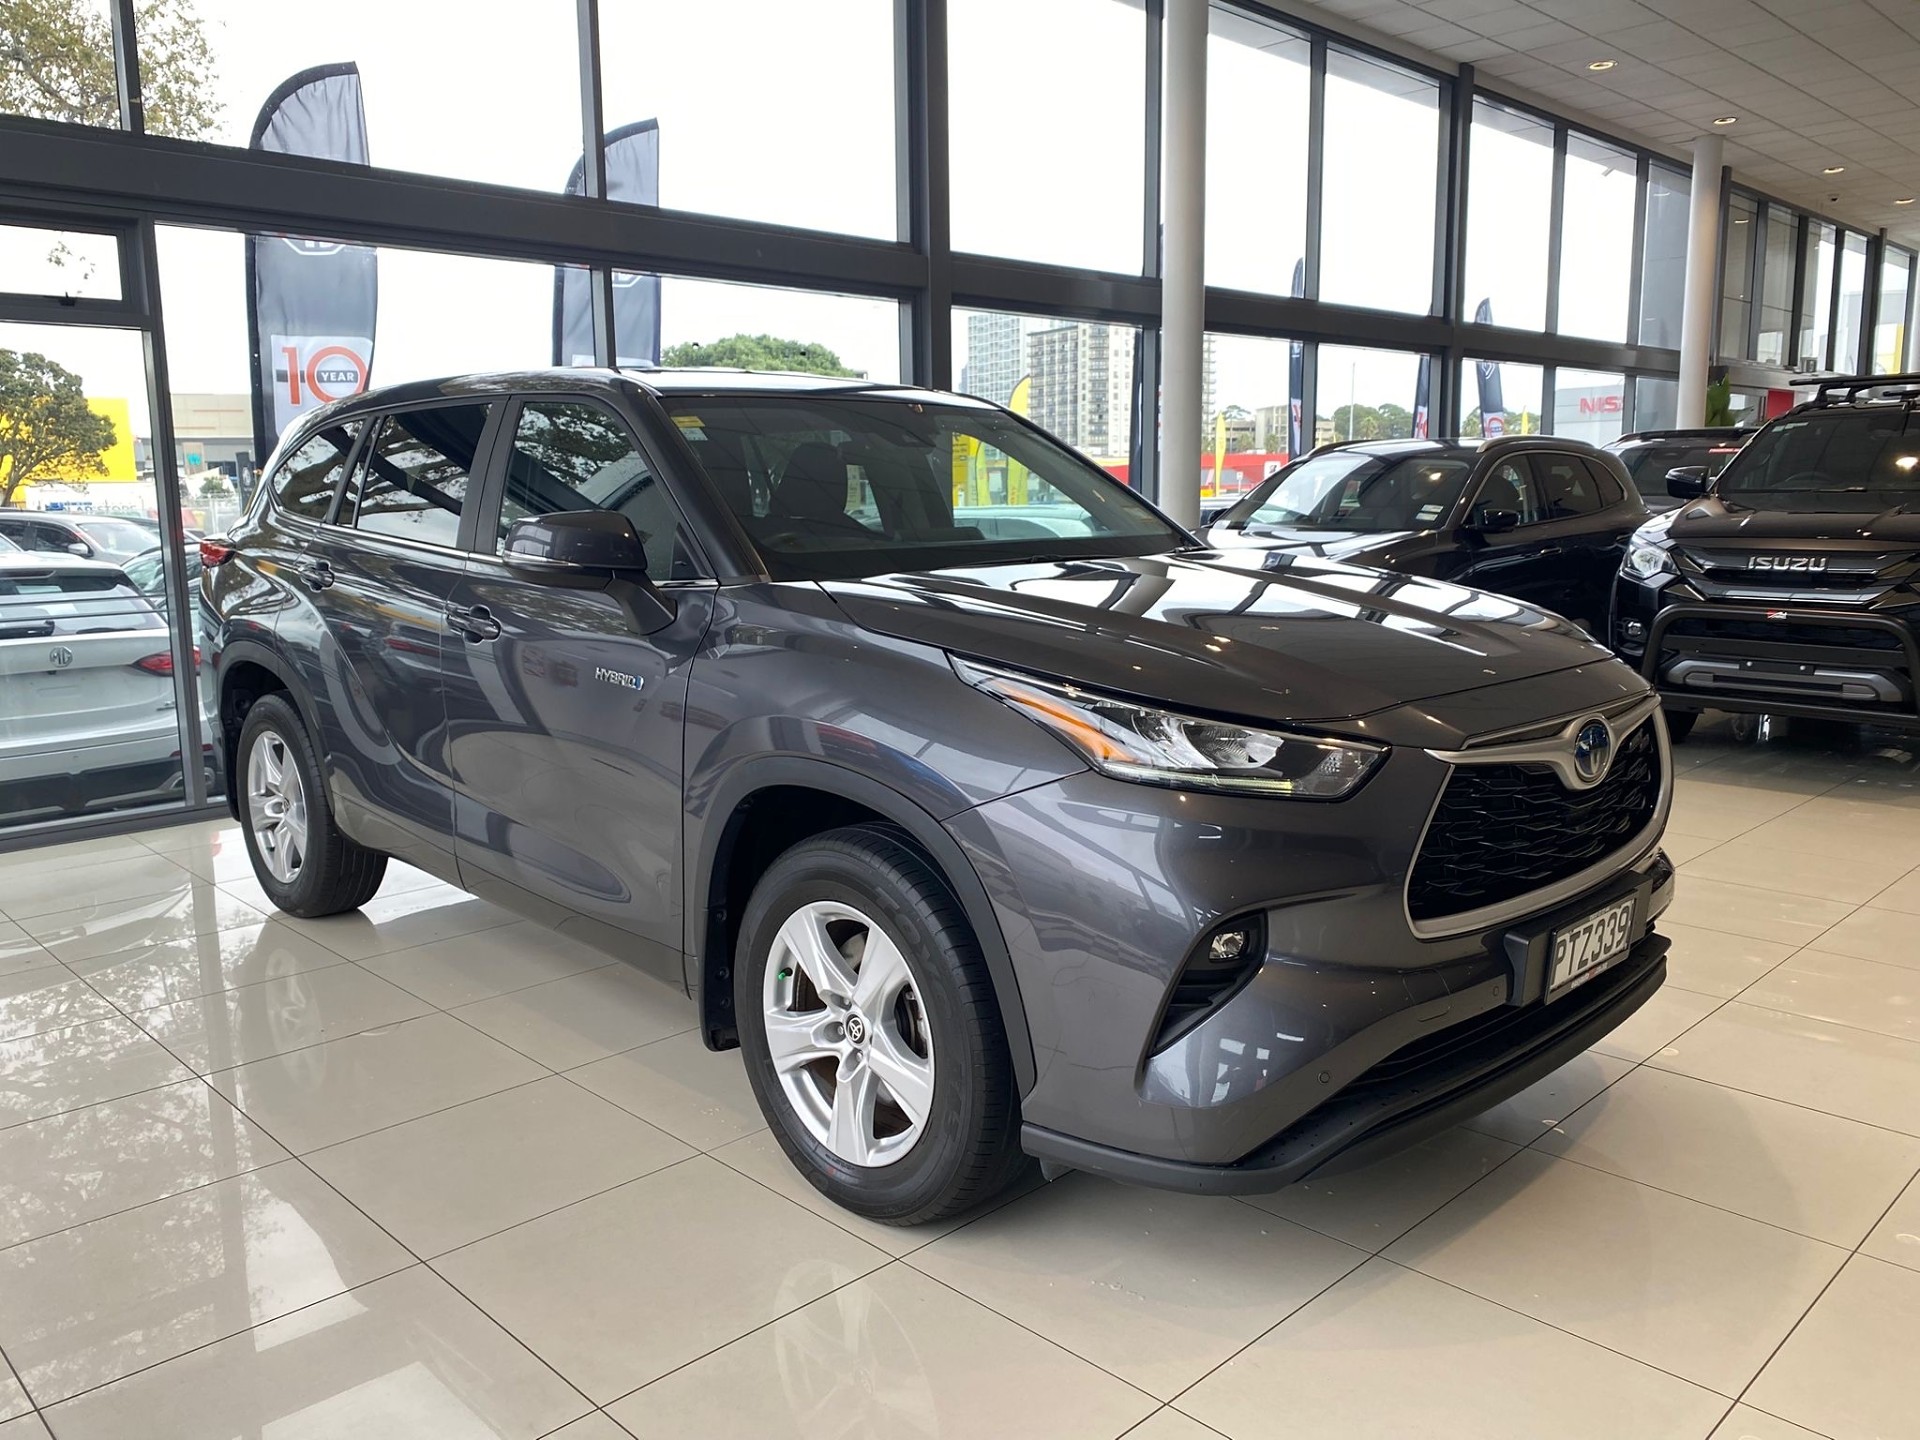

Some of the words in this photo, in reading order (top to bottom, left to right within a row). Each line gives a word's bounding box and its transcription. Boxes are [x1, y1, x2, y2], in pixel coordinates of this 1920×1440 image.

[282, 346, 367, 405] 10
[321, 371, 355, 382] YEAR
[1580, 395, 1624, 413] NIS
[1747, 556, 1827, 571] ISUZU
[51, 648, 73, 665] MG
[595, 667, 636, 689] HYBRID
[1551, 904, 1631, 987] PTZ339
